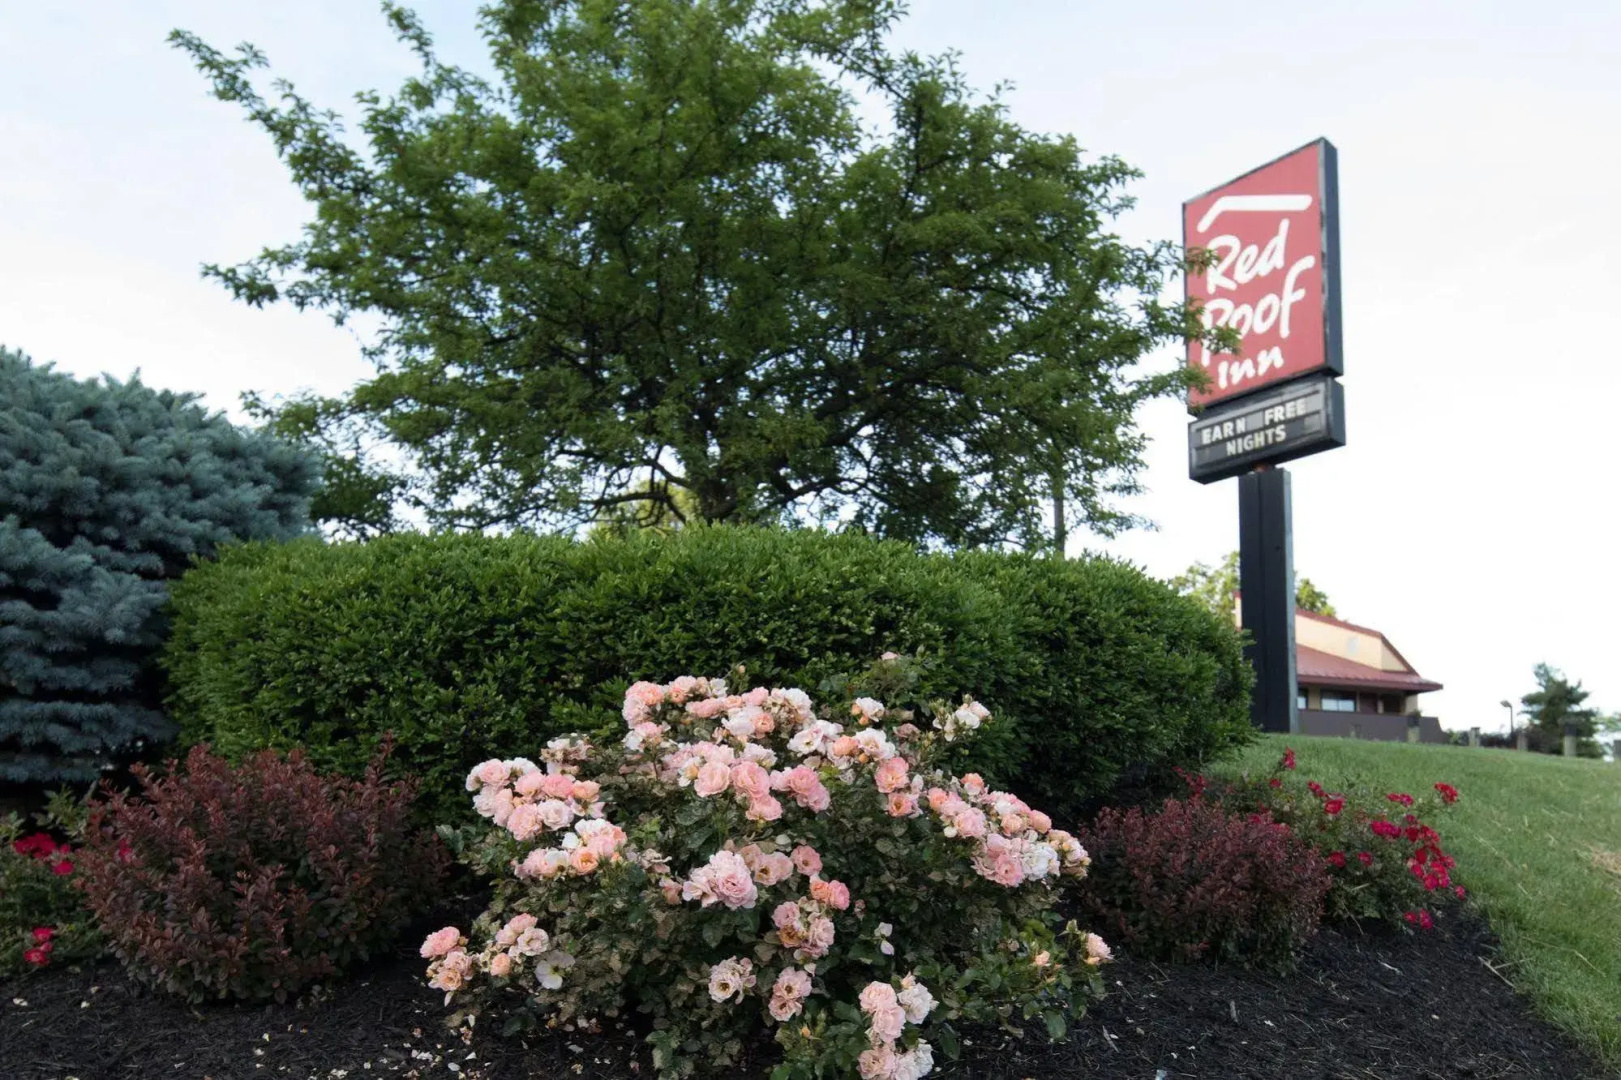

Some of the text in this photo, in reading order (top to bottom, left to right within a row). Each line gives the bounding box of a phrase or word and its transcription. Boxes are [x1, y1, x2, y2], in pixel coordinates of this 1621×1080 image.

[1207, 218, 1290, 295] Red
[1201, 255, 1316, 367] Roof
[1201, 399, 1307, 445] EARN FREE
[1226, 425, 1286, 456] NIGHTS
